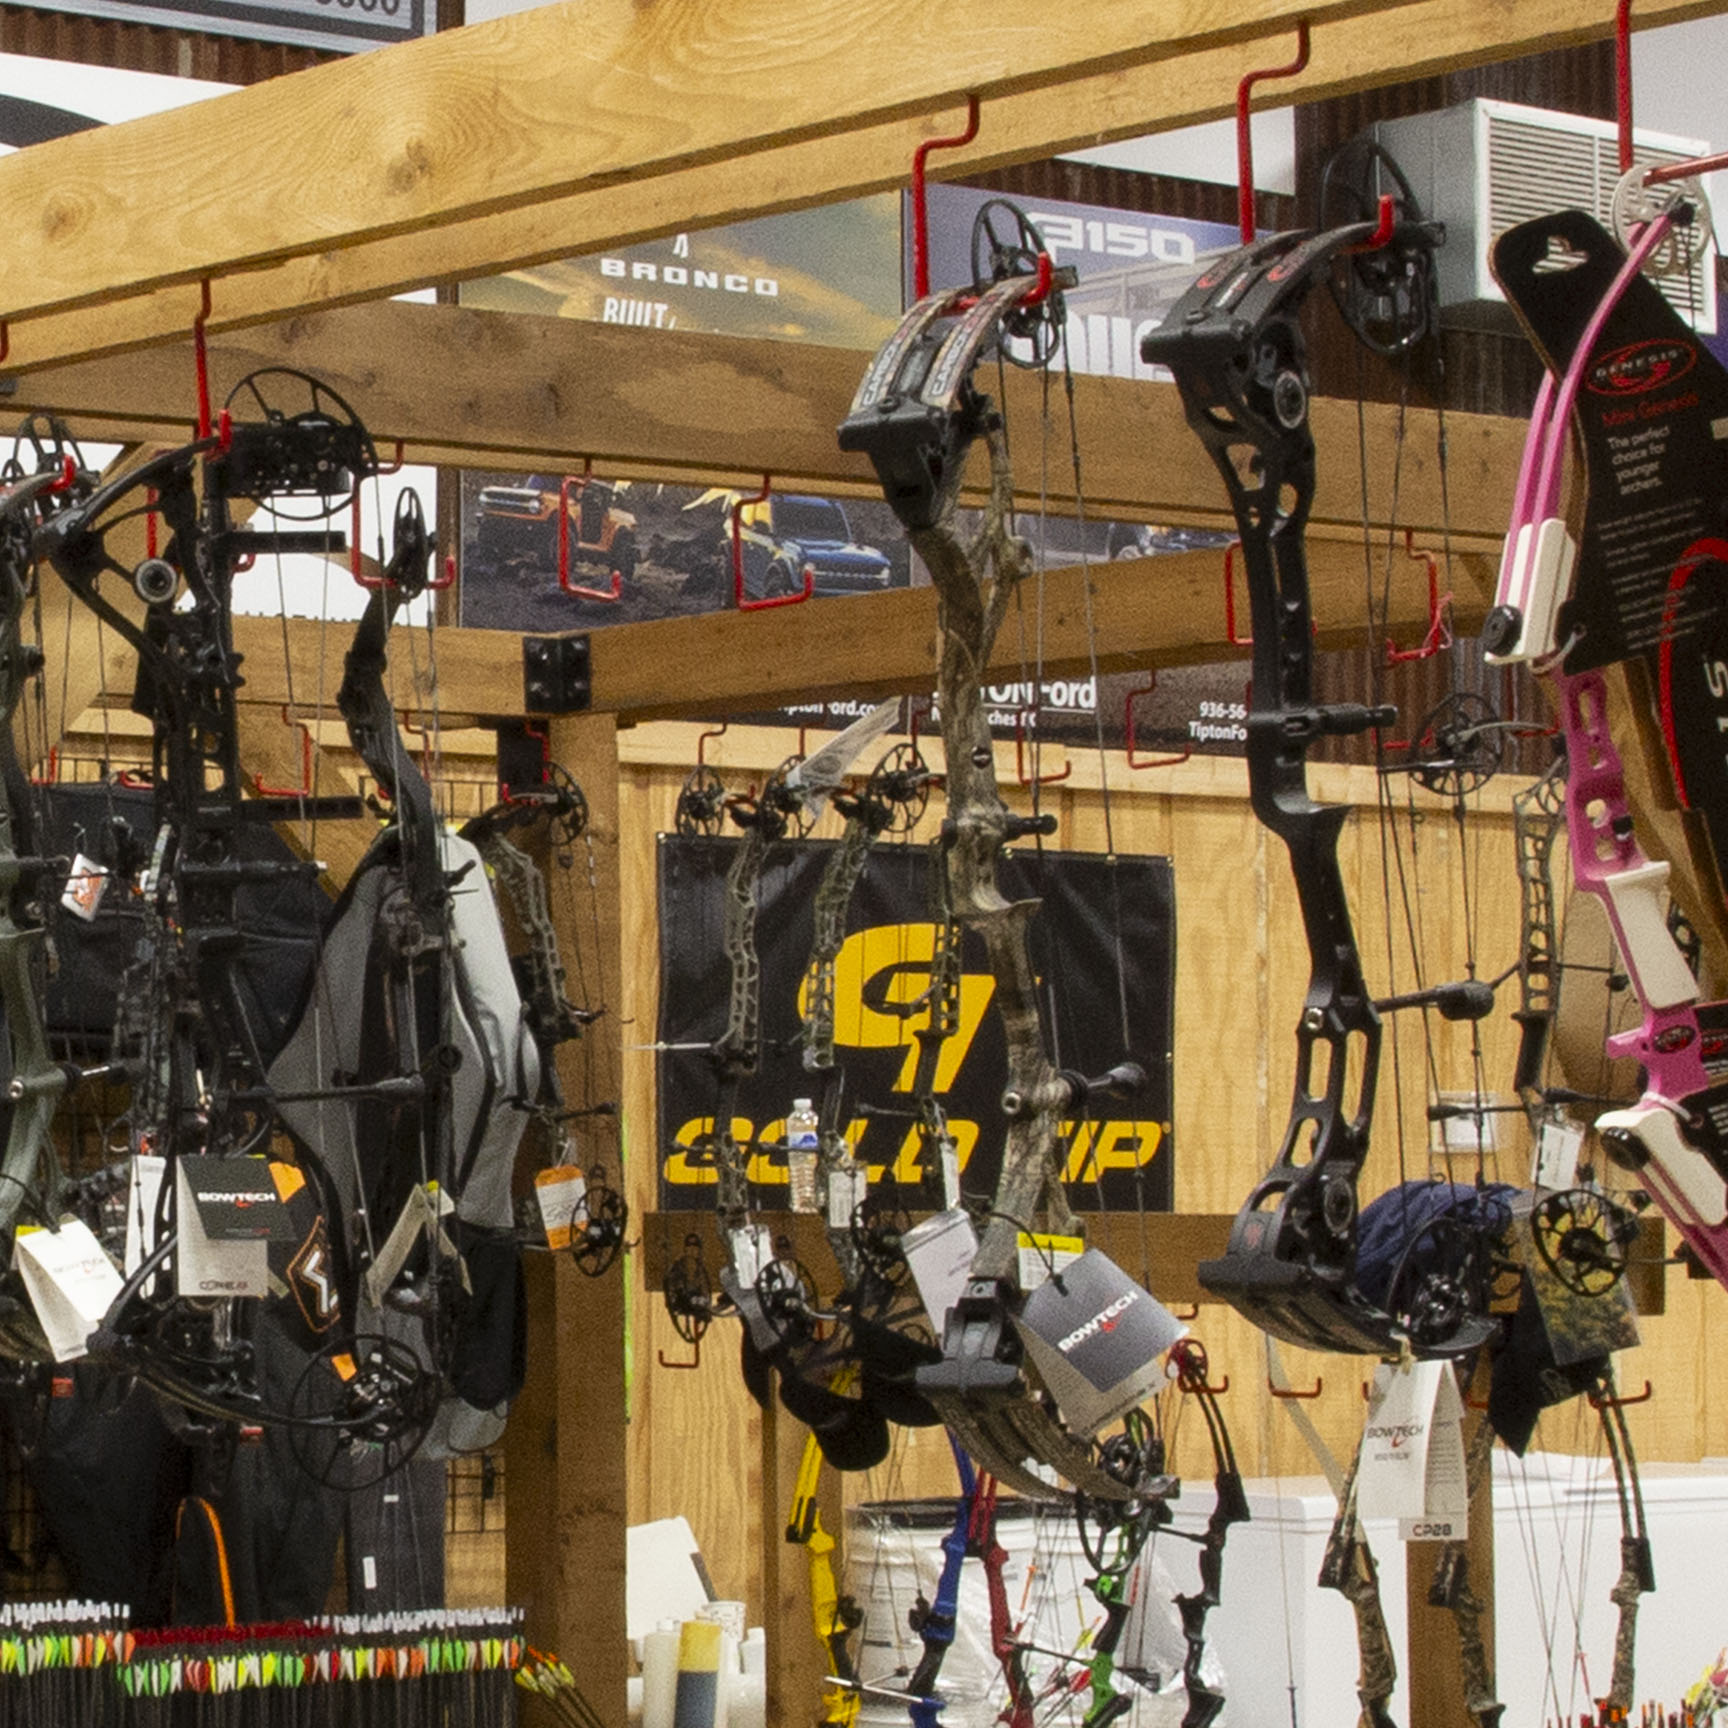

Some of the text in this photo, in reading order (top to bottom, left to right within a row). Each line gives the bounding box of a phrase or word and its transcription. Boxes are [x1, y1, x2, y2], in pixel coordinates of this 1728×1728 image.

[601, 258, 779, 297] BRONCO
[1608, 425, 1670, 449] The perfect
[1200, 701, 1248, 719] 936-56
[1188, 721, 1248, 742] TiptonFo
[198, 1191, 276, 1203] BOWTECH
[1058, 1290, 1139, 1352] BOWTECH
[1367, 1424, 1424, 1440] BOWTECH
